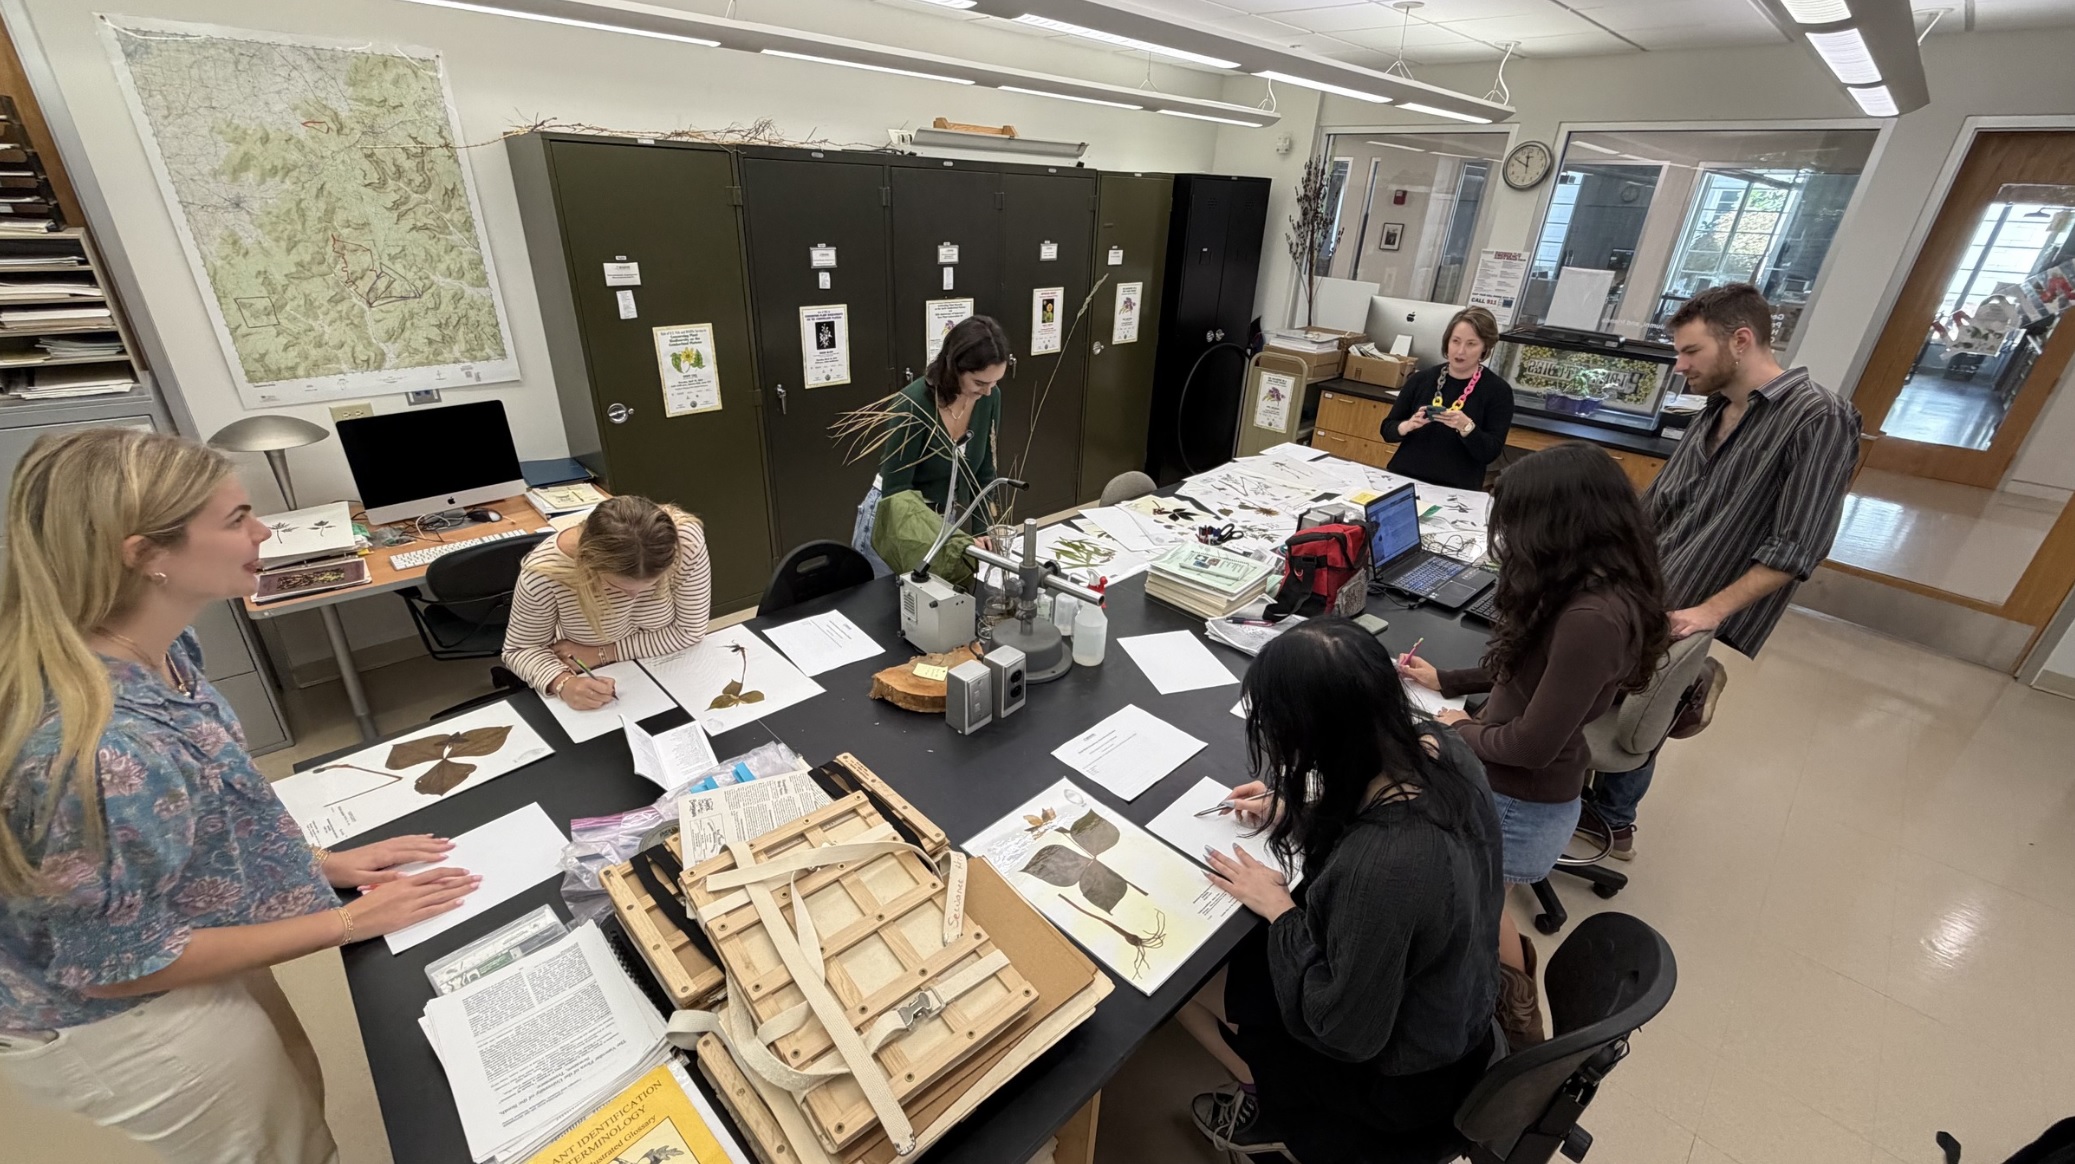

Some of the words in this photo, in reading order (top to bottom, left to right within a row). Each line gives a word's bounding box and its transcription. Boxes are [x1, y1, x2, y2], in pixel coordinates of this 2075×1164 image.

[552, 1144, 578, 1164] ANT
[576, 1079, 662, 1147] IDENTIFICATION
[566, 1104, 647, 1164] TERMINOLOGY
[590, 1139, 624, 1164] lustrated
[623, 1114, 657, 1142] Glossary
